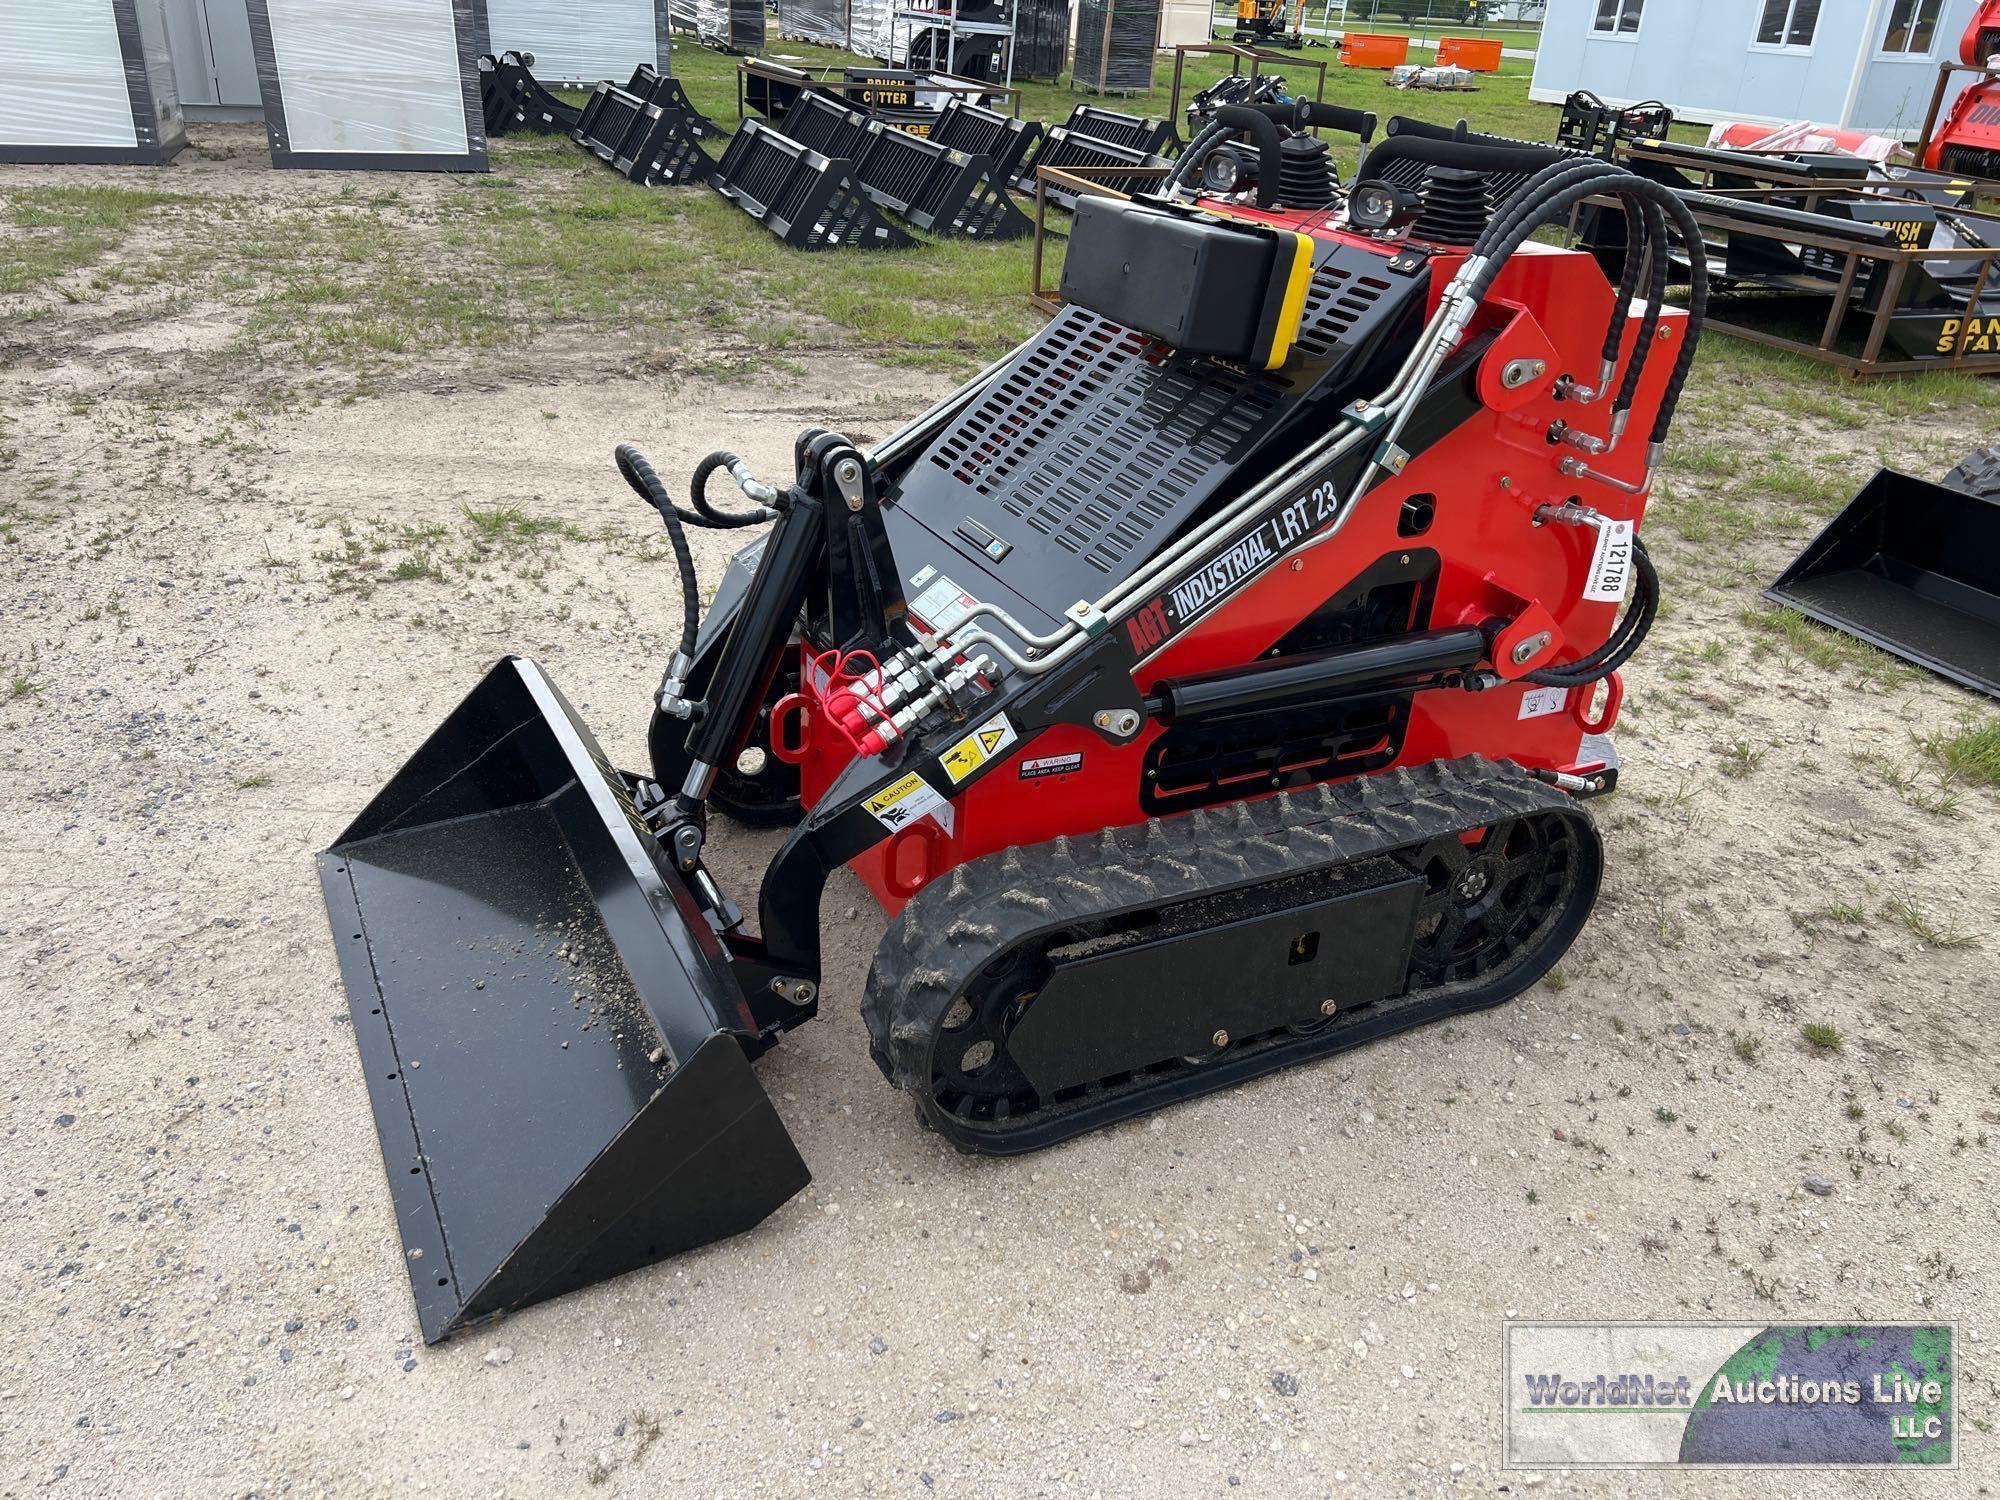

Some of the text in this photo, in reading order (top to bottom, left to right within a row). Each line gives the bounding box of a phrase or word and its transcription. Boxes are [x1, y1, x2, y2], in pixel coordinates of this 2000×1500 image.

[863, 91, 907, 105] CTTER
[1872, 221, 1922, 241] USH
[1602, 525, 1612, 551] WORLDNET
[1126, 480, 1338, 656] AGT INDUSTRIAL LRT 23
[1595, 552, 1606, 575] AUCTIONS
[1601, 541, 1629, 592] 121788
[882, 778, 919, 802] CAUTION
